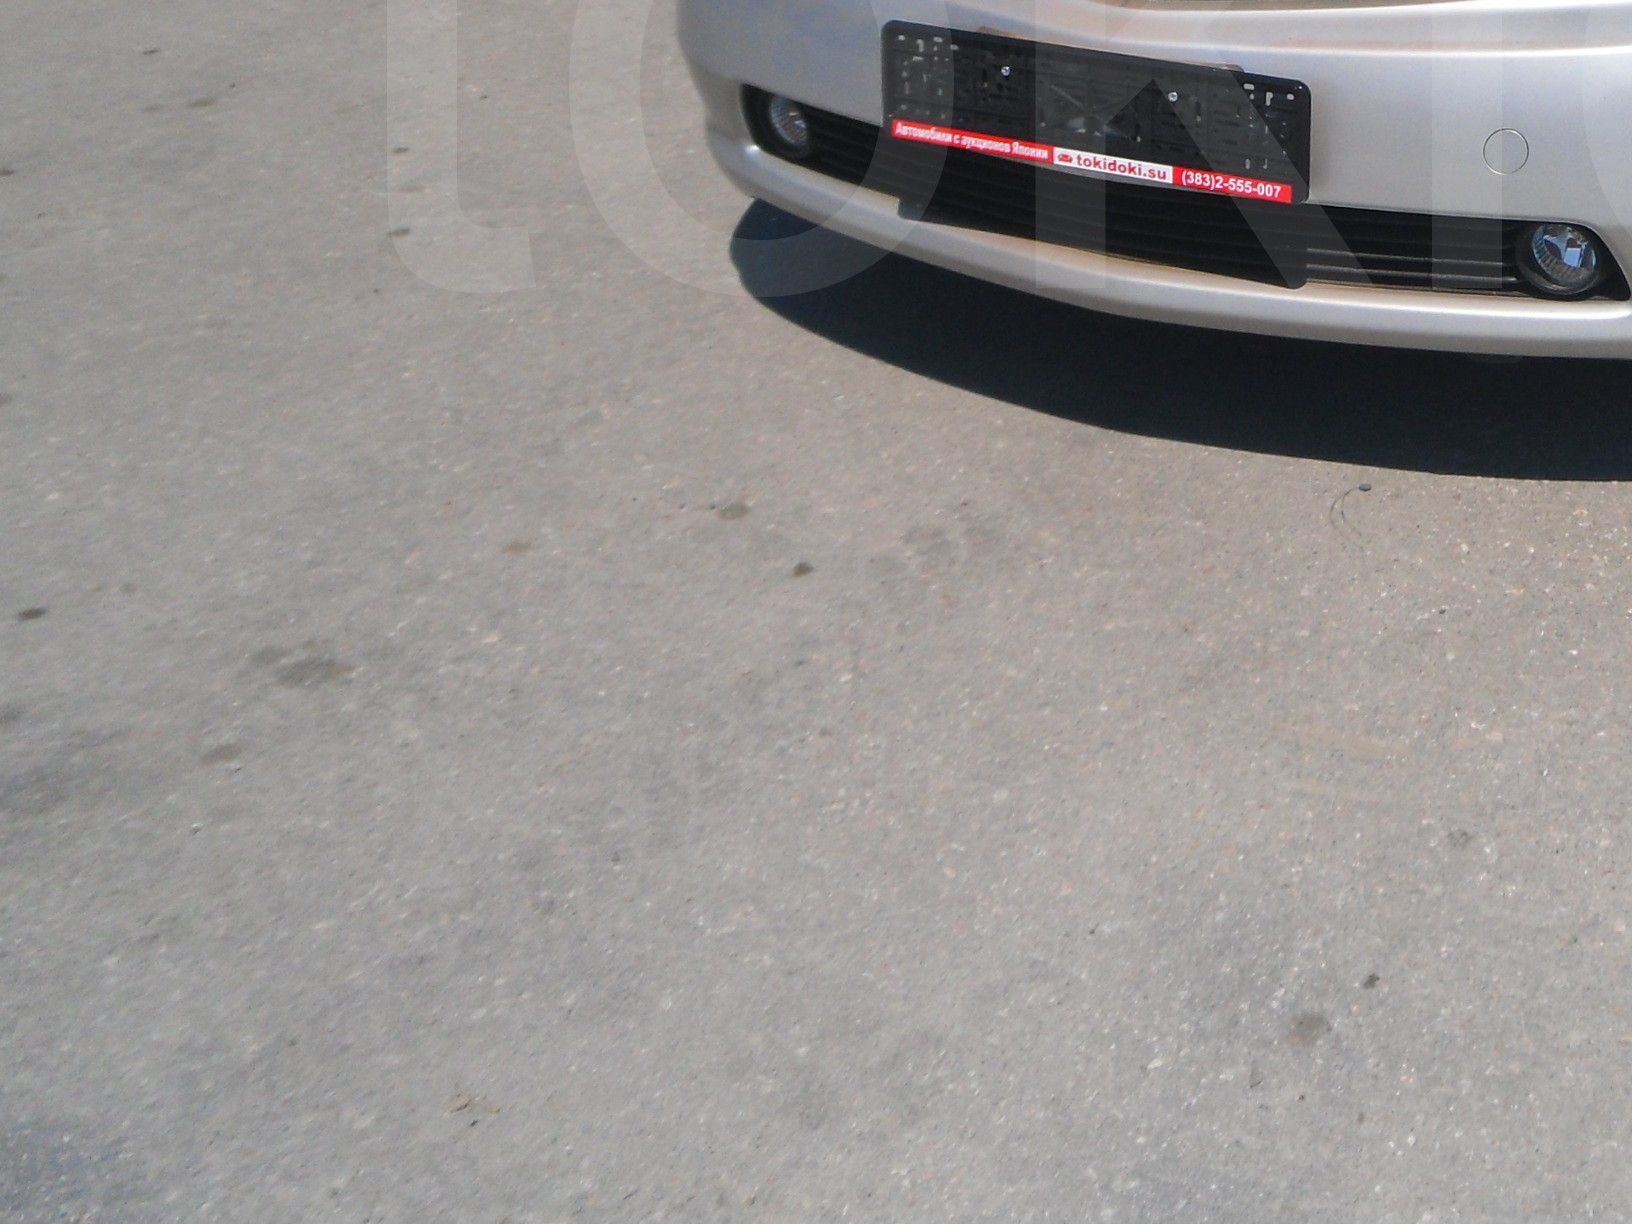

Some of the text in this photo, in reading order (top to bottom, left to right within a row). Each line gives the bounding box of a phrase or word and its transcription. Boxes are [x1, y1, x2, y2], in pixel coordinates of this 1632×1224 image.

[895, 122, 952, 143] Автомобили
[961, 134, 1012, 153] аукционов
[1011, 141, 1049, 160] Японии
[1075, 152, 1167, 181] tokidoki.su
[1181, 169, 1282, 198] (383)2-555-007
